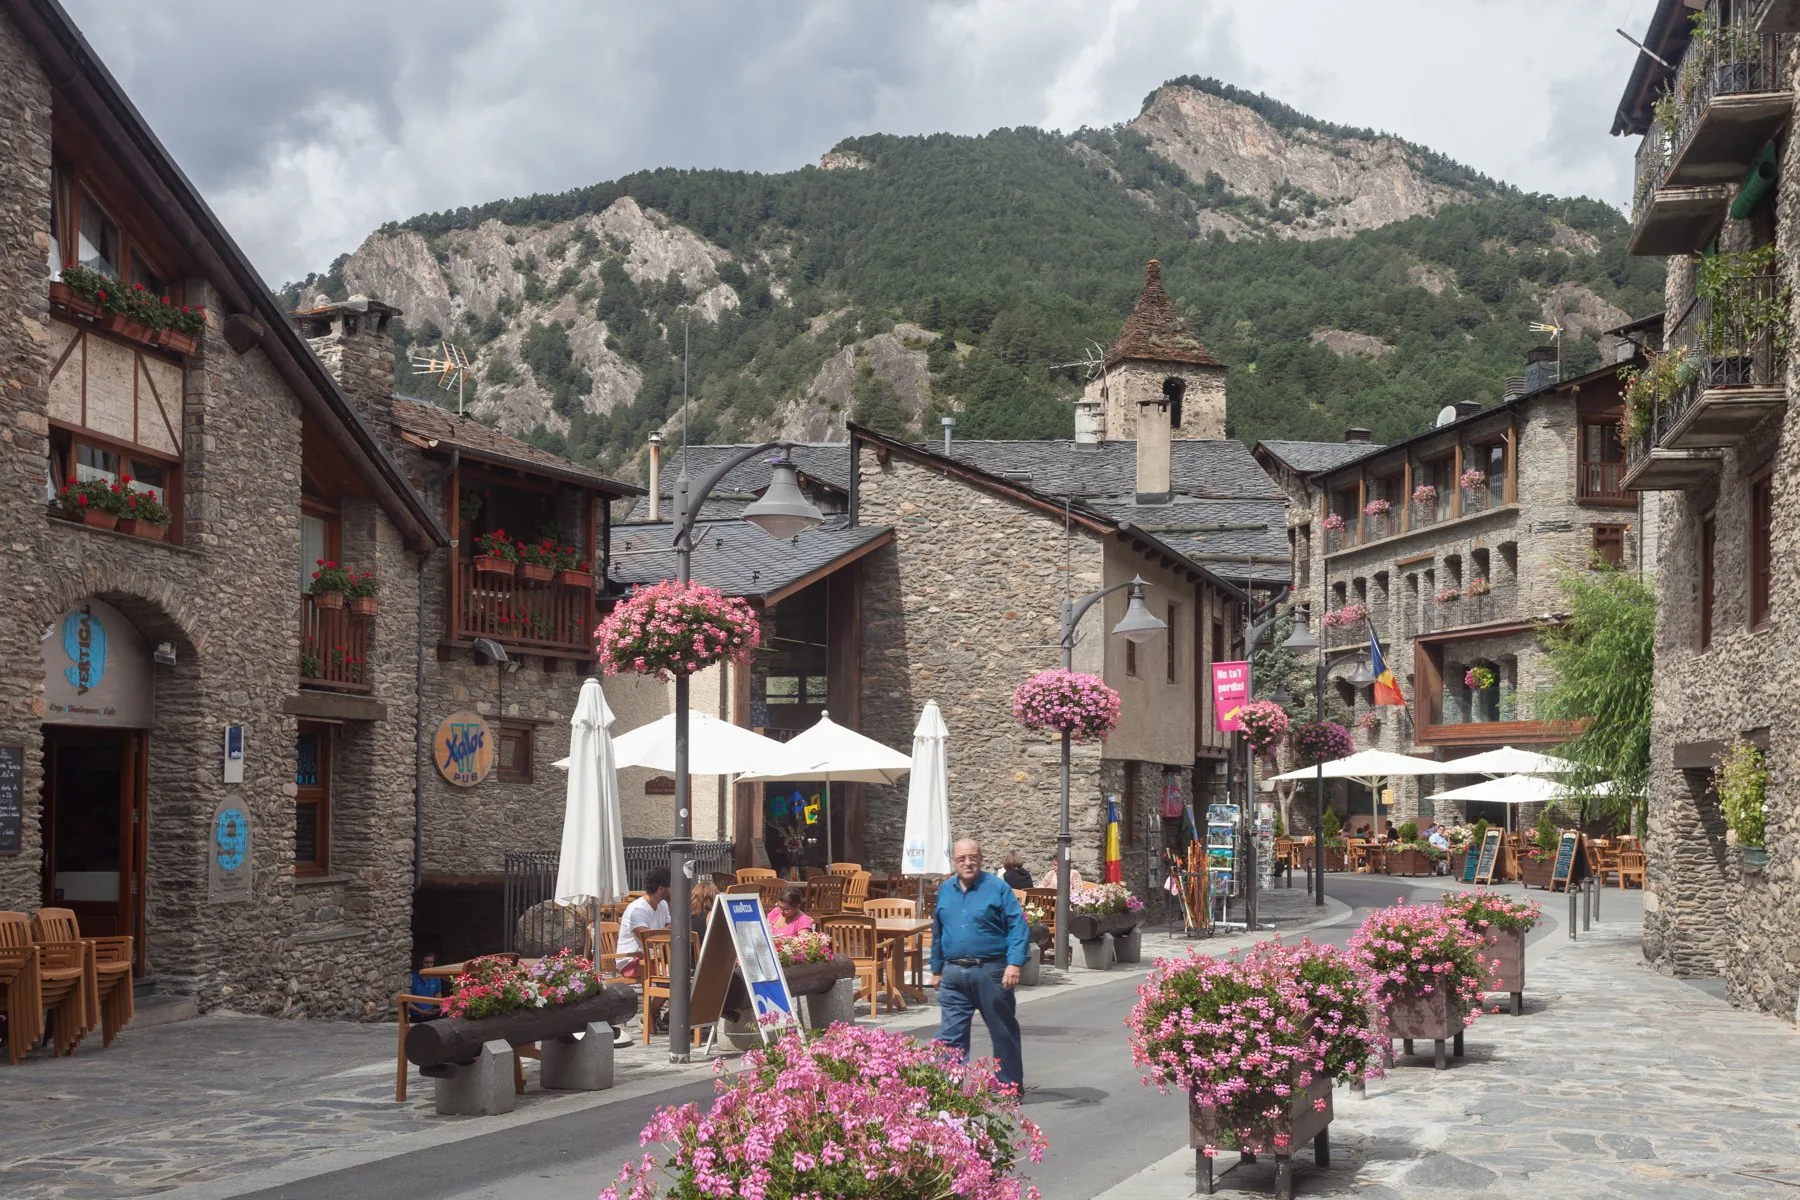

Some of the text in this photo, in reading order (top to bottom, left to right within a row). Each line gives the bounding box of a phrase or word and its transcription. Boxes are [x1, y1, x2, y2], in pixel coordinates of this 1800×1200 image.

[78, 605, 91, 696] VERTICAL
[1218, 669, 1228, 679] No
[443, 730, 484, 769] Xaloc
[453, 772, 478, 783] PUB
